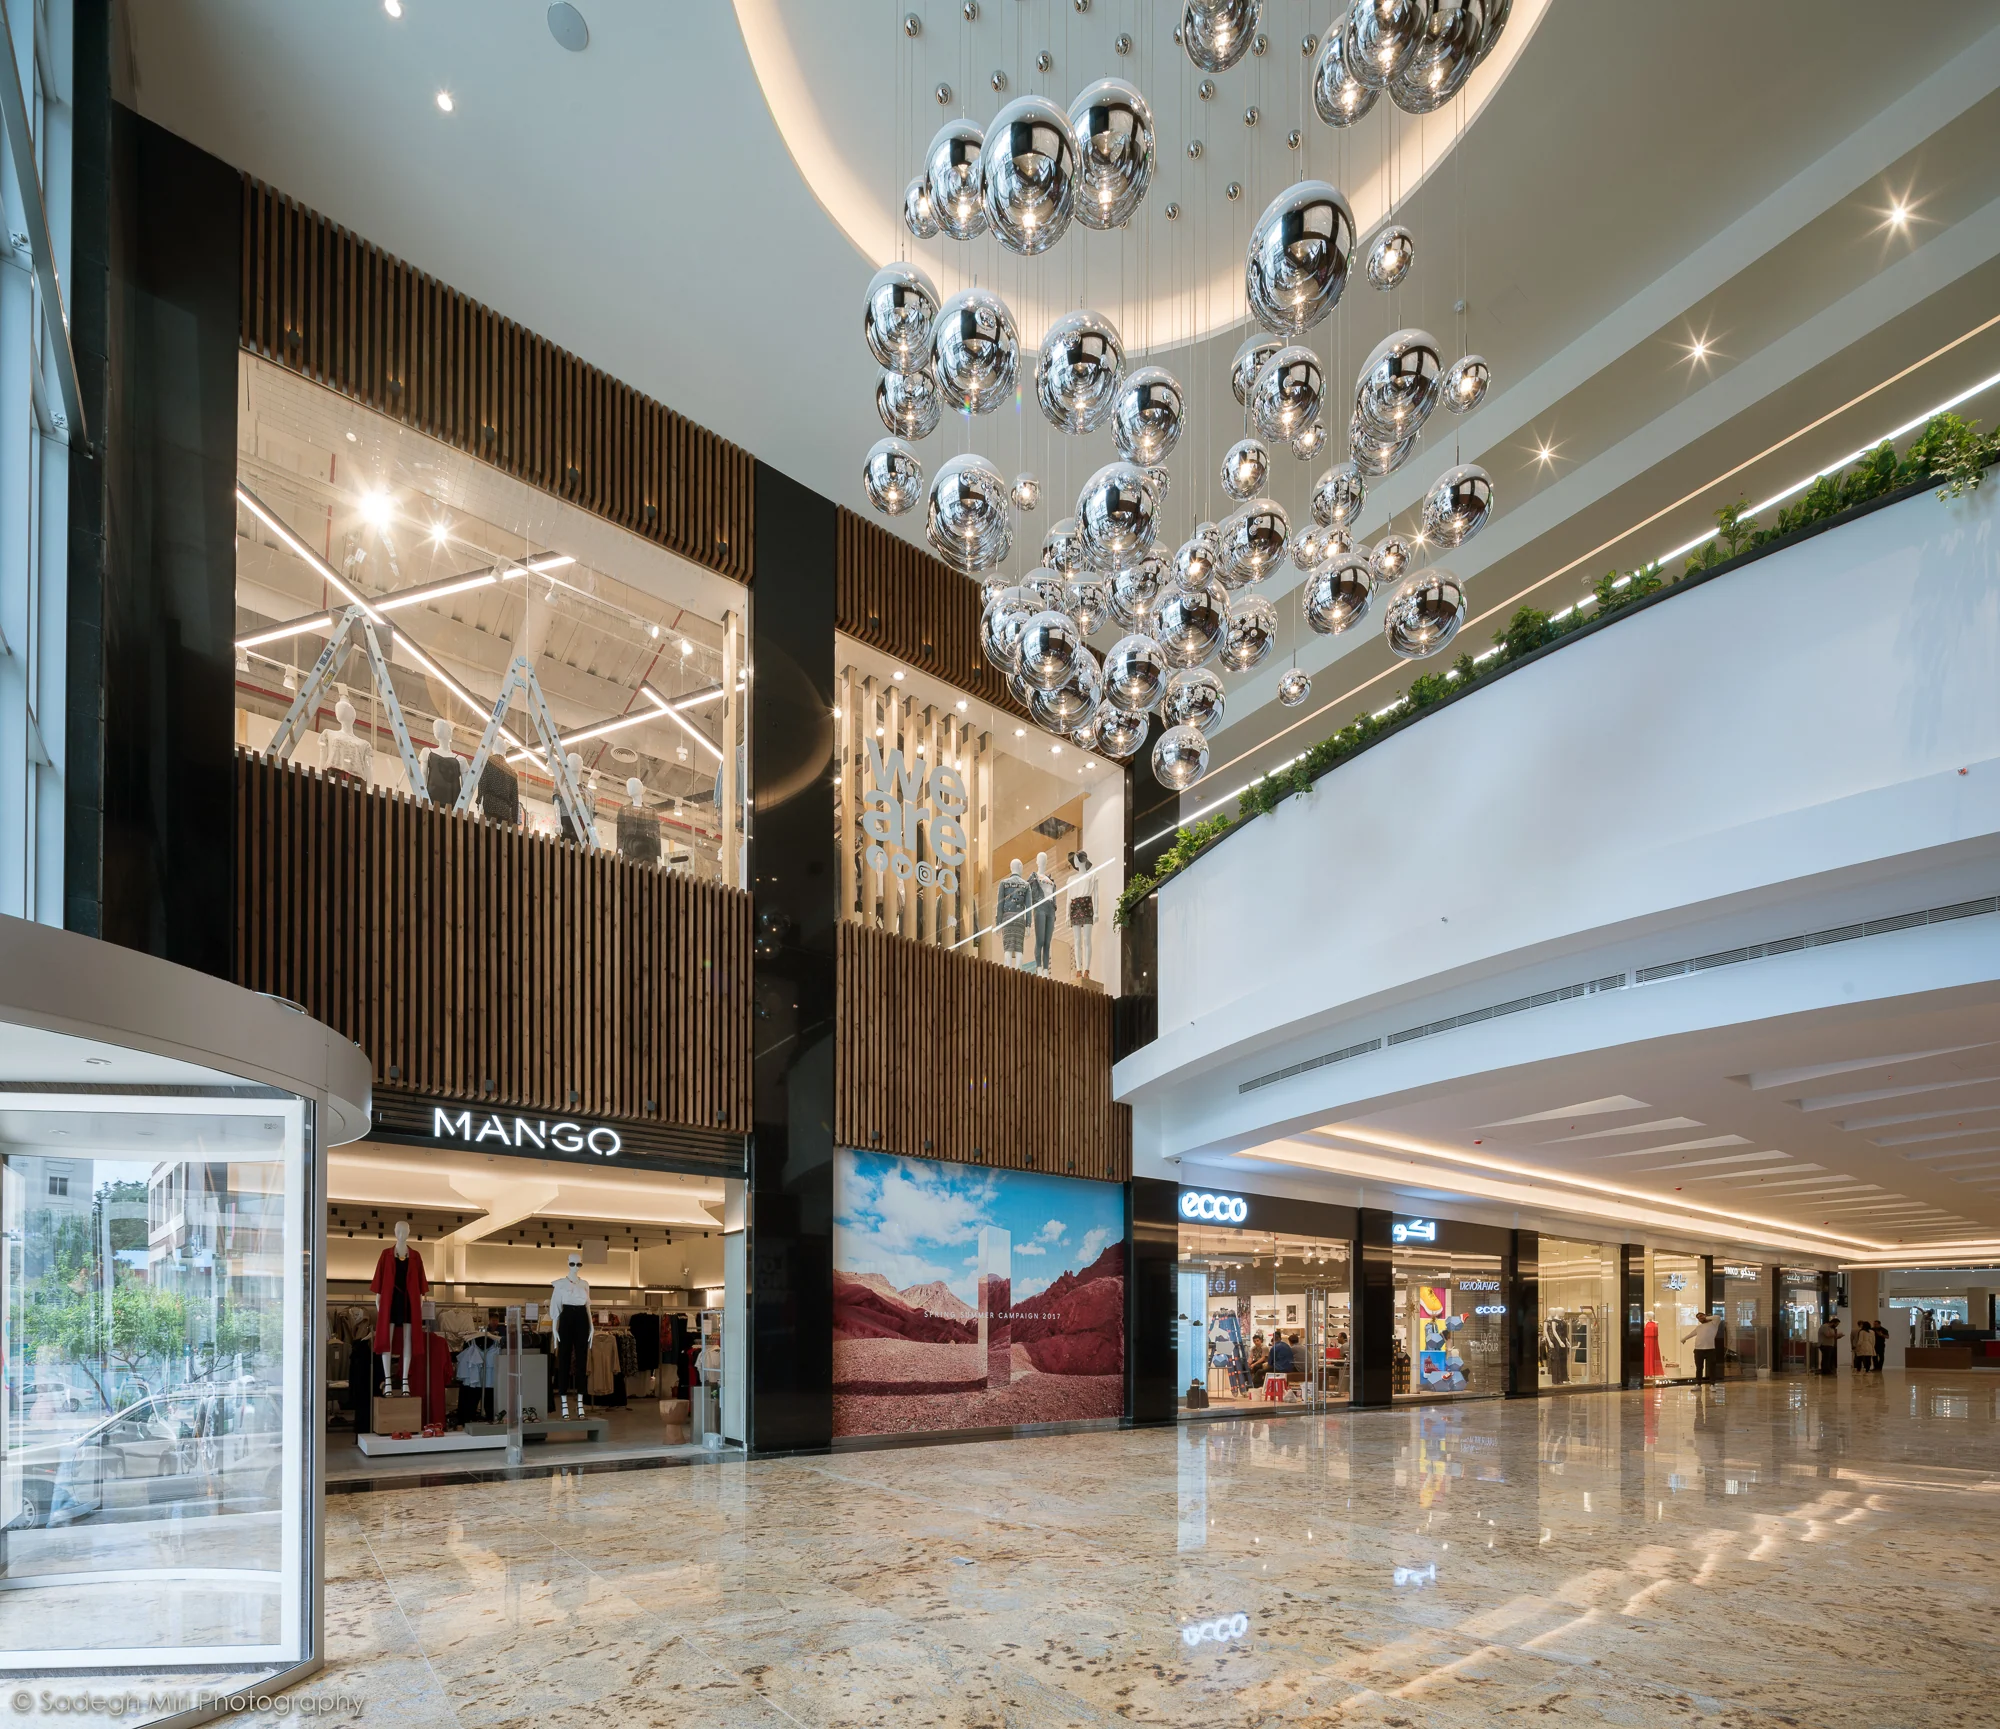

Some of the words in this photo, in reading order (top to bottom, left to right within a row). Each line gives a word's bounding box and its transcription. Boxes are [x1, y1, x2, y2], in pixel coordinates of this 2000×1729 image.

[865, 737, 967, 817] we
[863, 790, 967, 867] are
[434, 1107, 621, 1156] MANGO
[1180, 1191, 1248, 1223] ecco
[923, 1310, 956, 1319] SPRING
[960, 1311, 994, 1320] SUMMER
[998, 1312, 1039, 1320] CAMPAIGN
[1475, 1305, 1507, 1315] ecco
